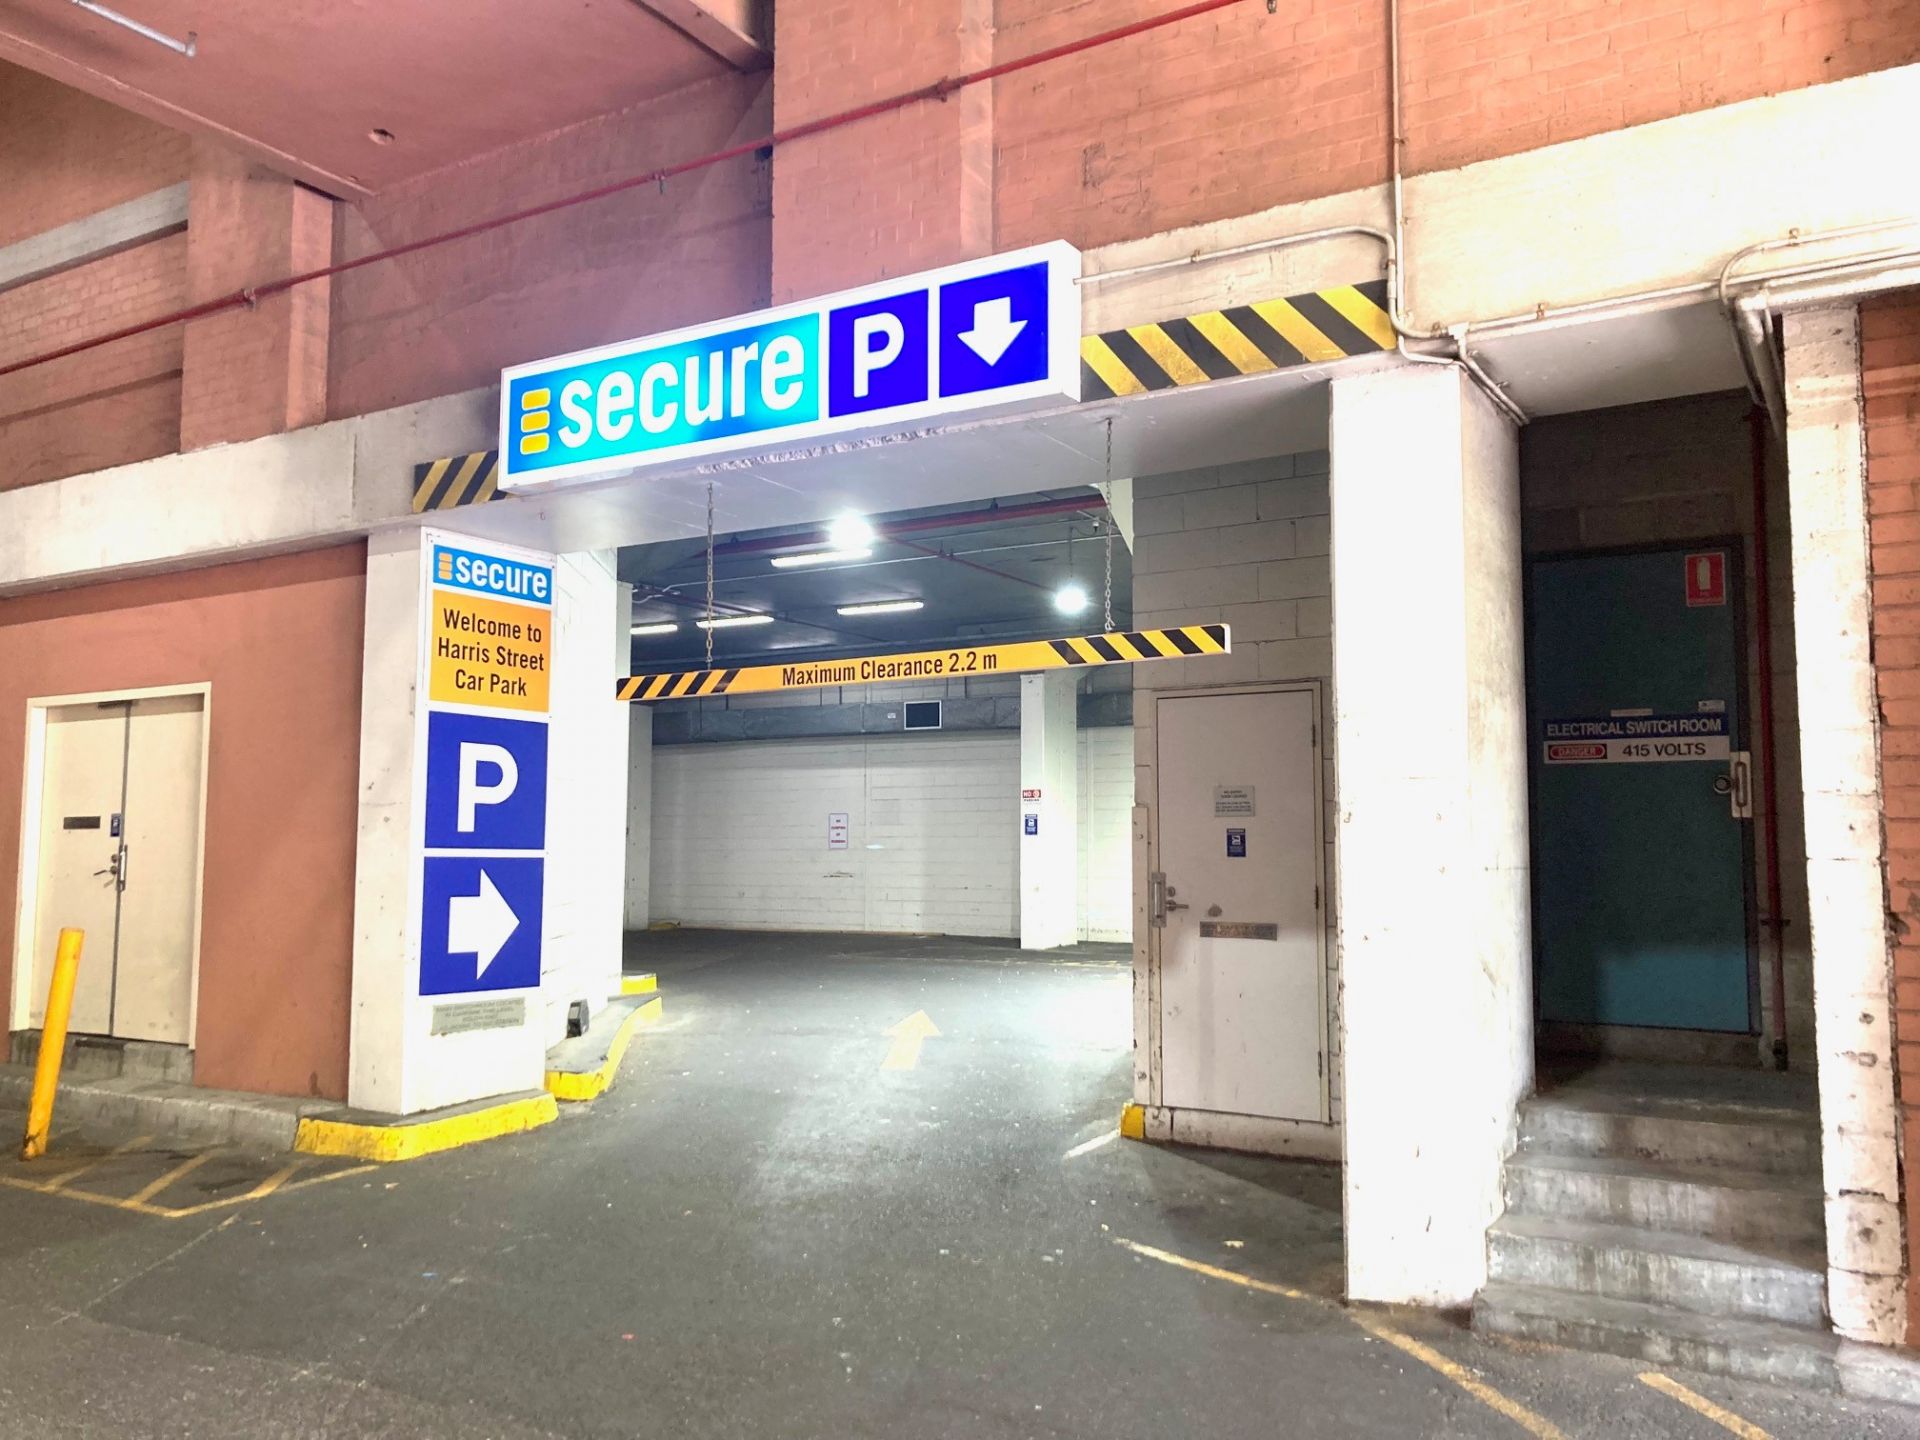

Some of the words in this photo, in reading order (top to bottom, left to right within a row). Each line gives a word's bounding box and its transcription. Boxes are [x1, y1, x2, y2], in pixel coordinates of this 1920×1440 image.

[853, 312, 905, 398] P
[558, 334, 805, 448] secure
[455, 556, 547, 598] secure
[444, 608, 521, 640] Welcome
[527, 623, 542, 643] to
[438, 637, 490, 664] Harris
[496, 645, 545, 671] Street
[782, 664, 855, 686] Maximum
[861, 658, 943, 680] Clearance
[949, 651, 977, 672] 2.2
[983, 653, 997, 670] m
[455, 669, 484, 692] Car
[490, 673, 527, 697] Park
[1547, 721, 1622, 736] ELECTRICAL
[1626, 720, 1677, 734] SWITCH
[1681, 719, 1721, 732] ROOM
[1557, 747, 1597, 757] DANGER
[1622, 745, 1650, 757] 415
[1655, 742, 1706, 756] VOLTS
[457, 741, 519, 832] P
